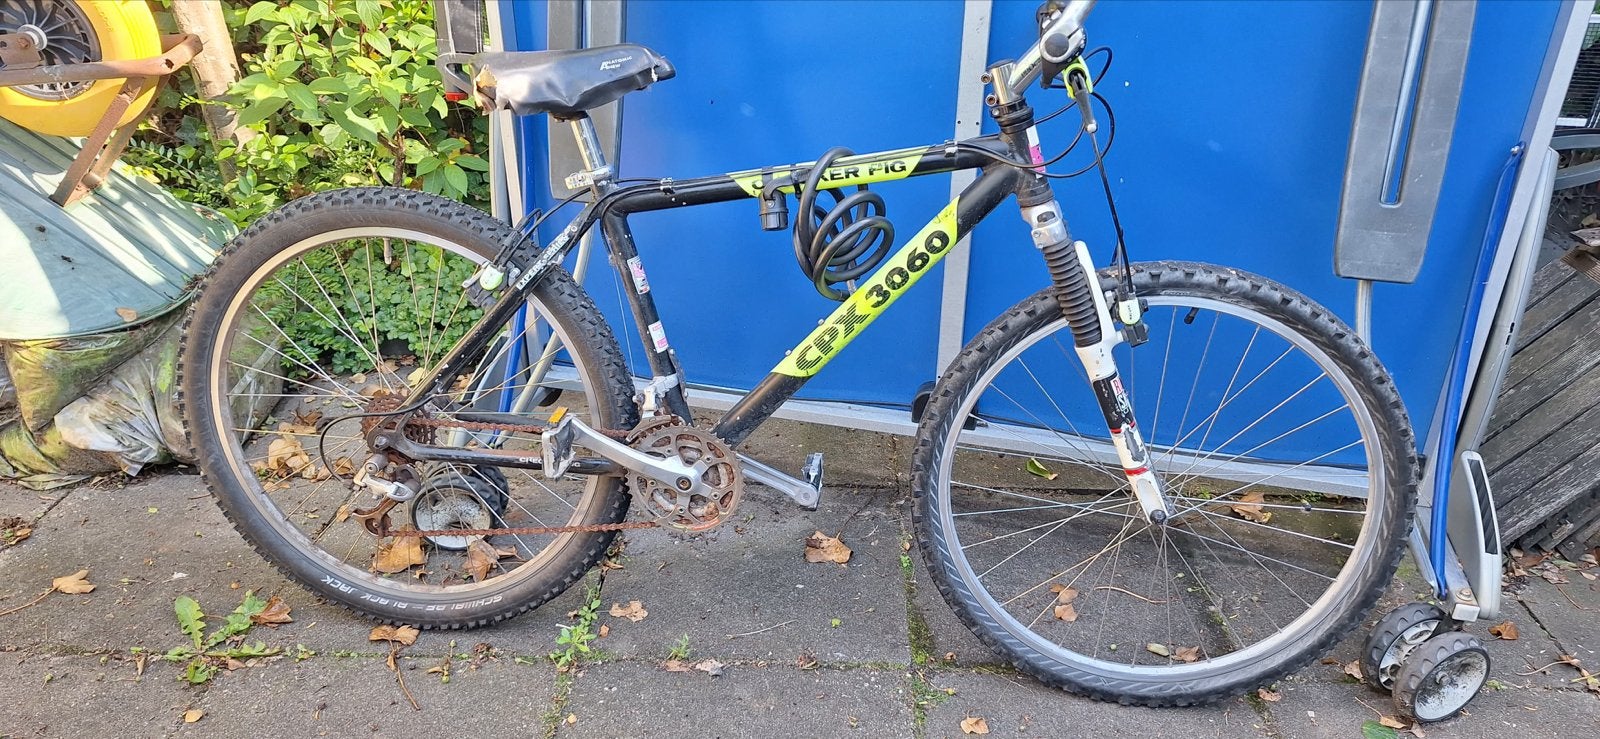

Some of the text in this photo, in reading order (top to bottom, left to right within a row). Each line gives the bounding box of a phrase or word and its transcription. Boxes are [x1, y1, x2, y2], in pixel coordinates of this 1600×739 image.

[868, 160, 907, 176] PIG
[795, 230, 950, 371] CPX 3060
[321, 575, 358, 595] JACK
